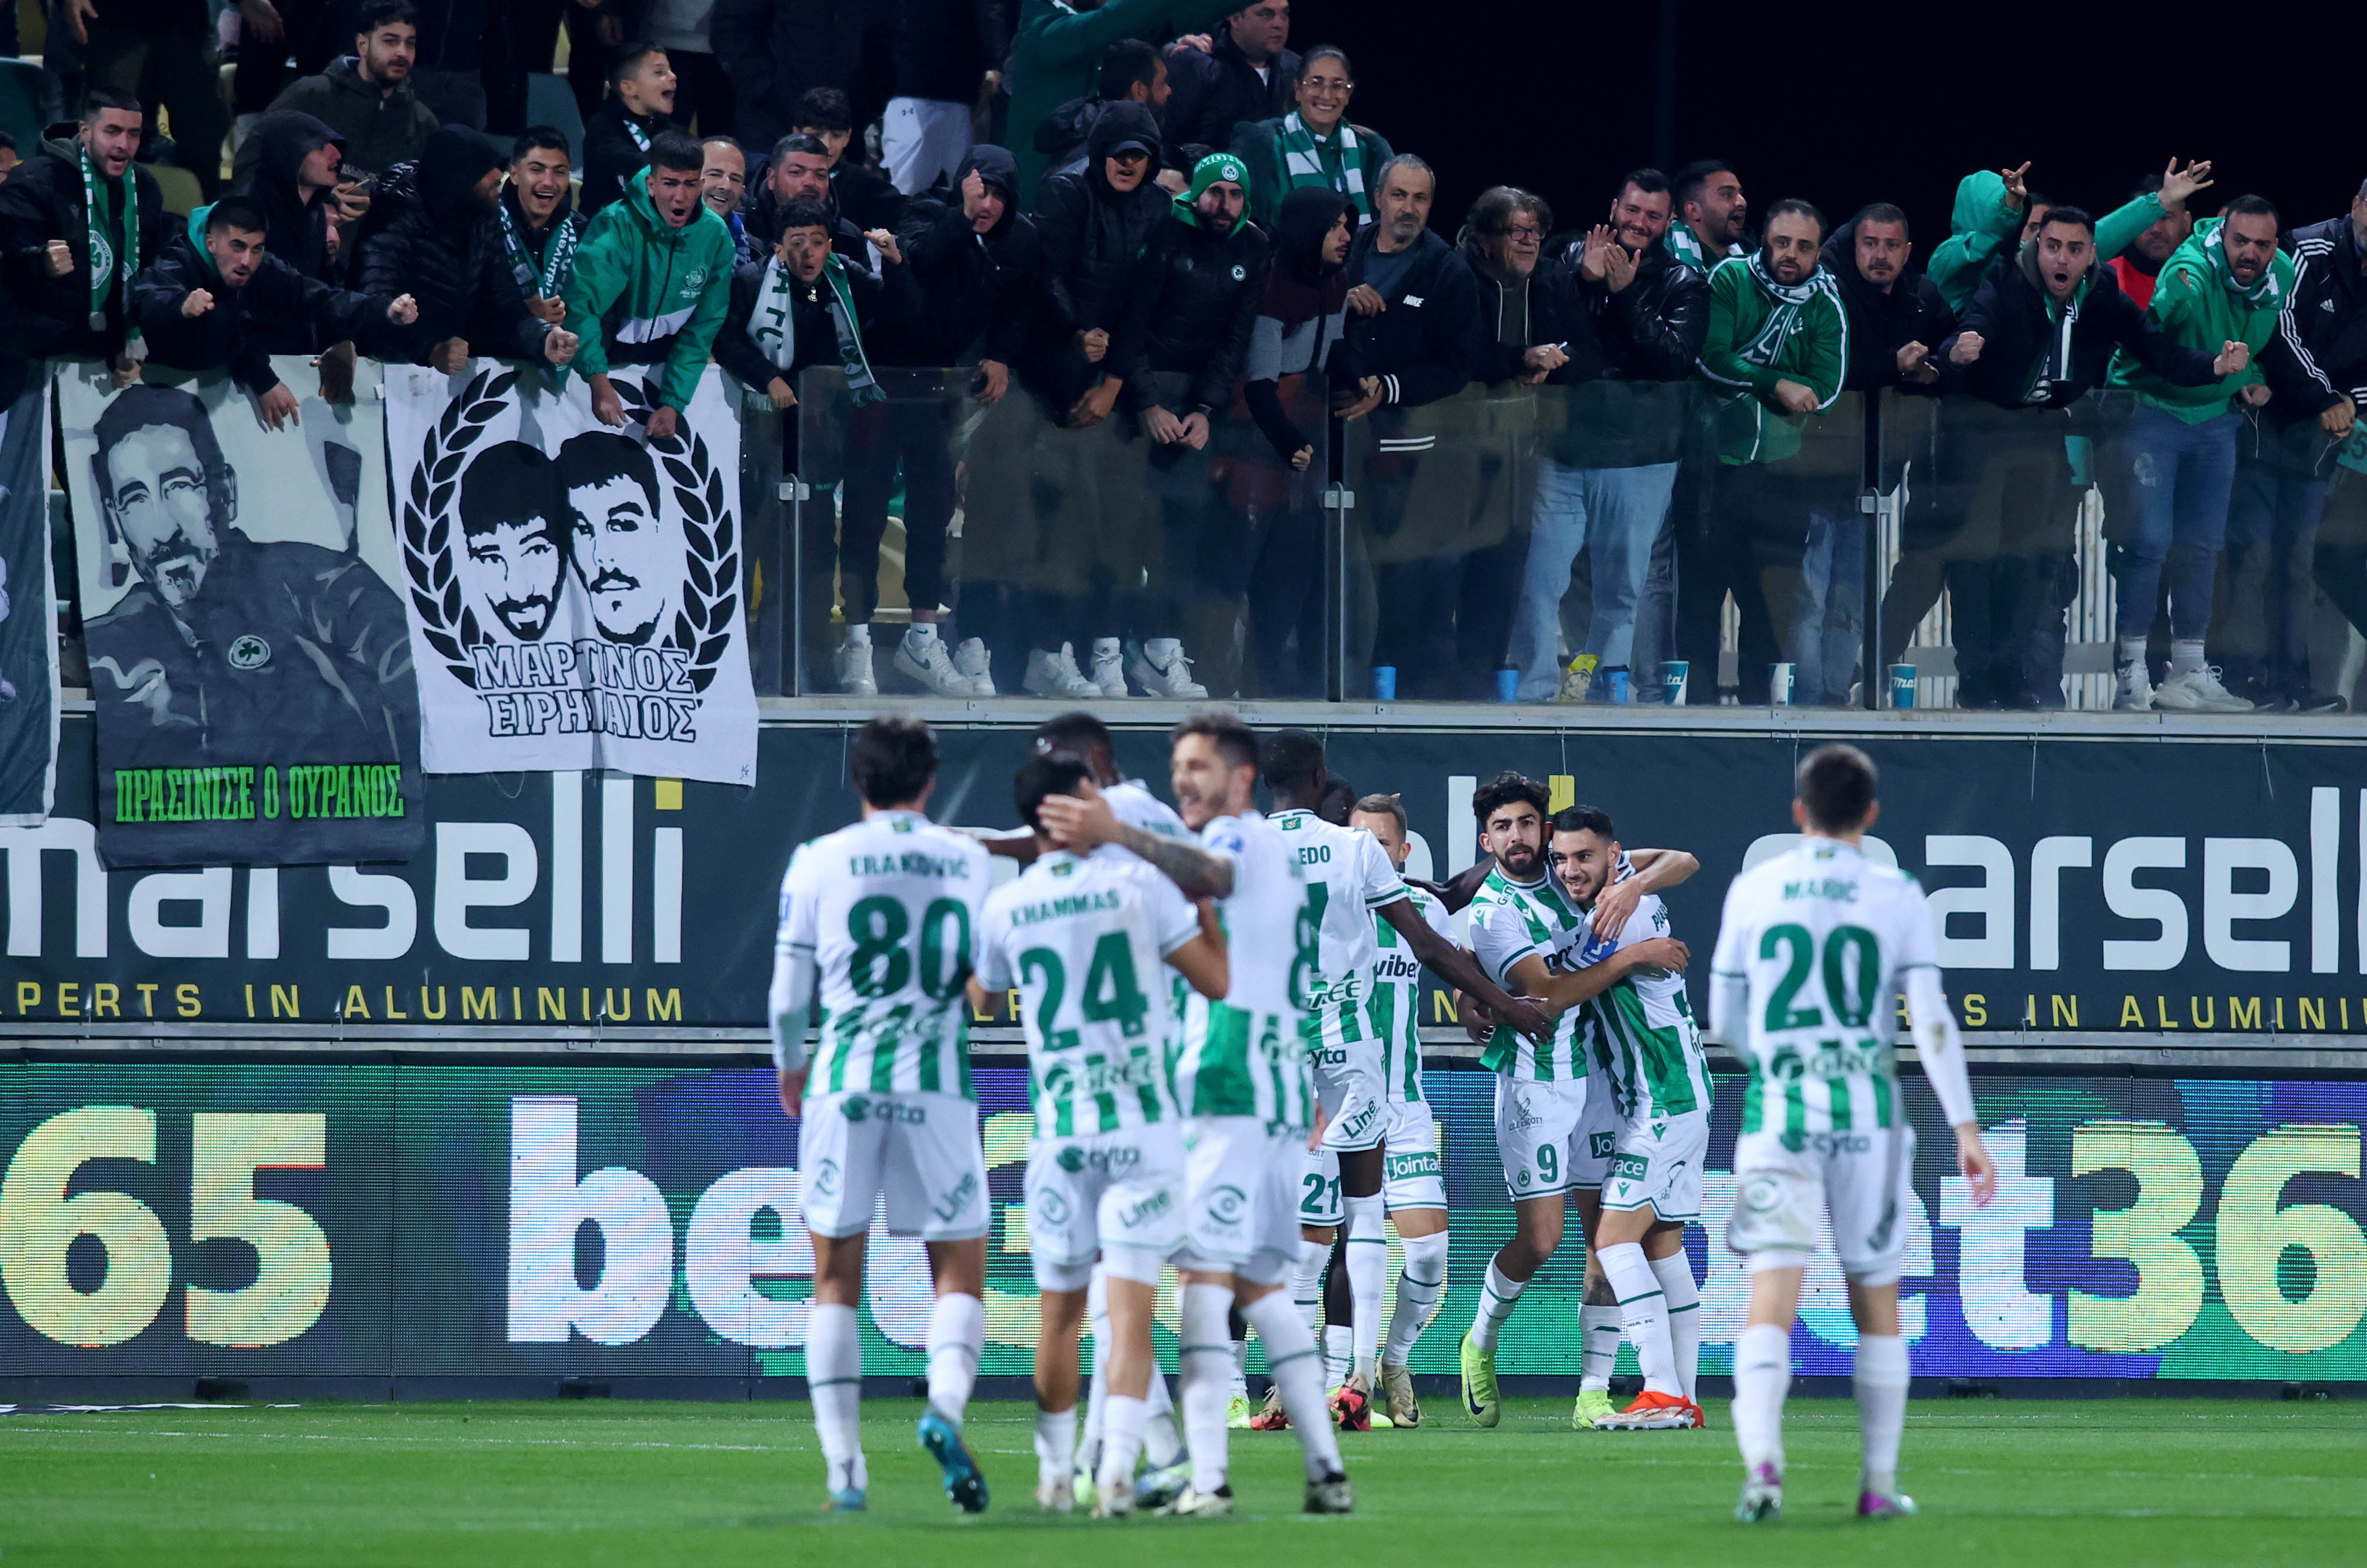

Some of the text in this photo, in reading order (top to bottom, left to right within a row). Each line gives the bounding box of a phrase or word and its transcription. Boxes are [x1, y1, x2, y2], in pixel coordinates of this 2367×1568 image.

[1402, 294, 1424, 307] NIKE
[1662, 674, 1682, 686] ta
[115, 767, 255, 821] ΠΡΑΣΙΝΙΣΕ
[289, 765, 404, 818] ΟΥΡΑΝΟΣ
[848, 894, 970, 1000] 80
[1019, 928, 1149, 1052] 24
[1760, 922, 1880, 1032] 20
[0, 981, 683, 1021] PERTS IN ALUMINIUM
[2028, 994, 2367, 1030] IN ALUMINI
[1342, 1096, 1377, 1139] Line
[1537, 1143, 1558, 1183] 9
[1595, 1133, 1615, 1156] Joi
[1300, 1173, 1339, 1214] 21
[0, 1105, 333, 1347] 65
